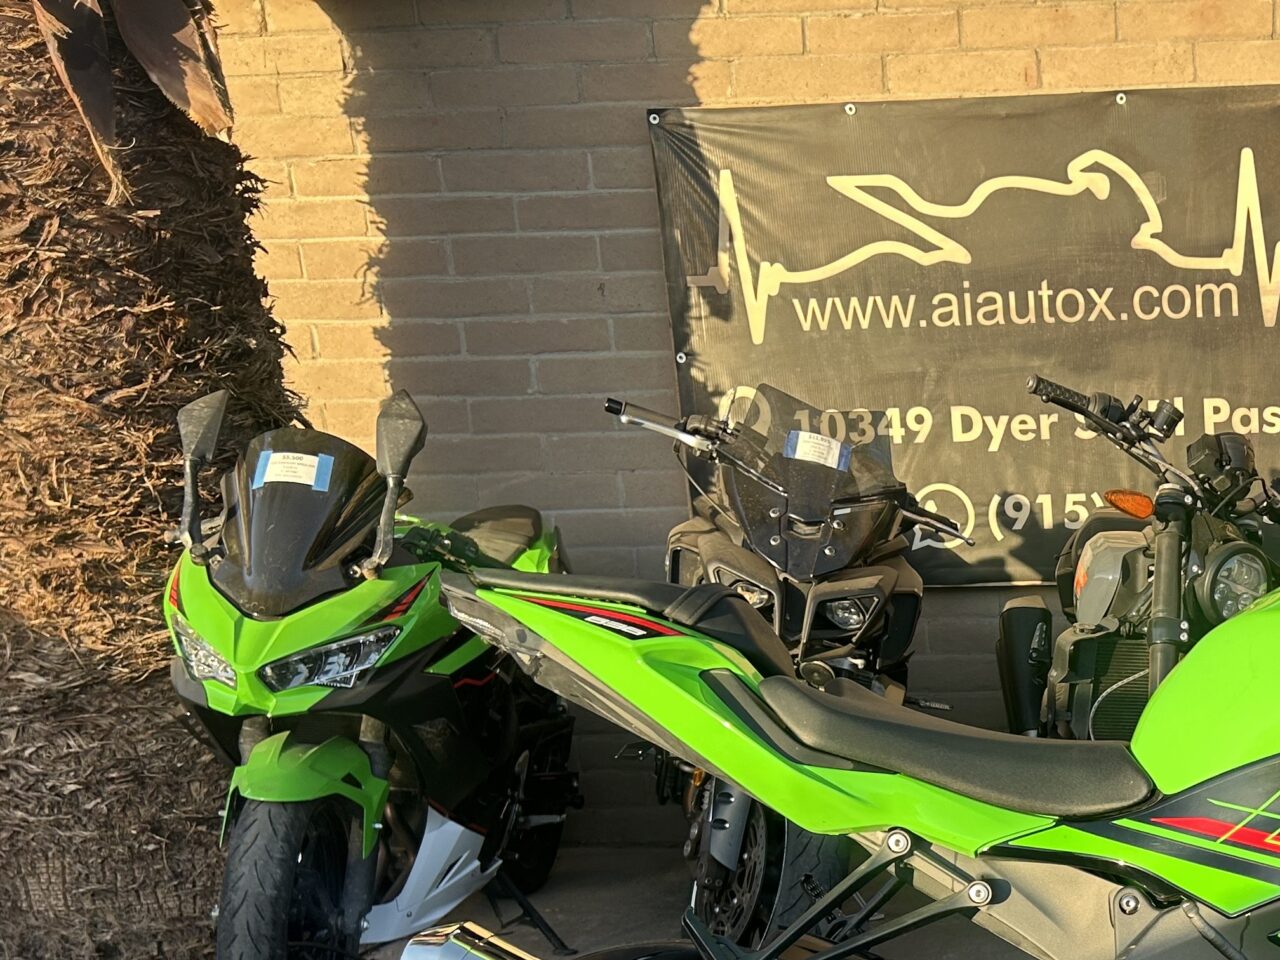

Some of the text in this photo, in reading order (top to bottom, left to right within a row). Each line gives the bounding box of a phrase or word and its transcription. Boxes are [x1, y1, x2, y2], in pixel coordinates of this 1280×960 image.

[792, 279, 1239, 331] www.aiautox.com
[793, 405, 933, 444] 10349
[949, 405, 1058, 452] Dyer
